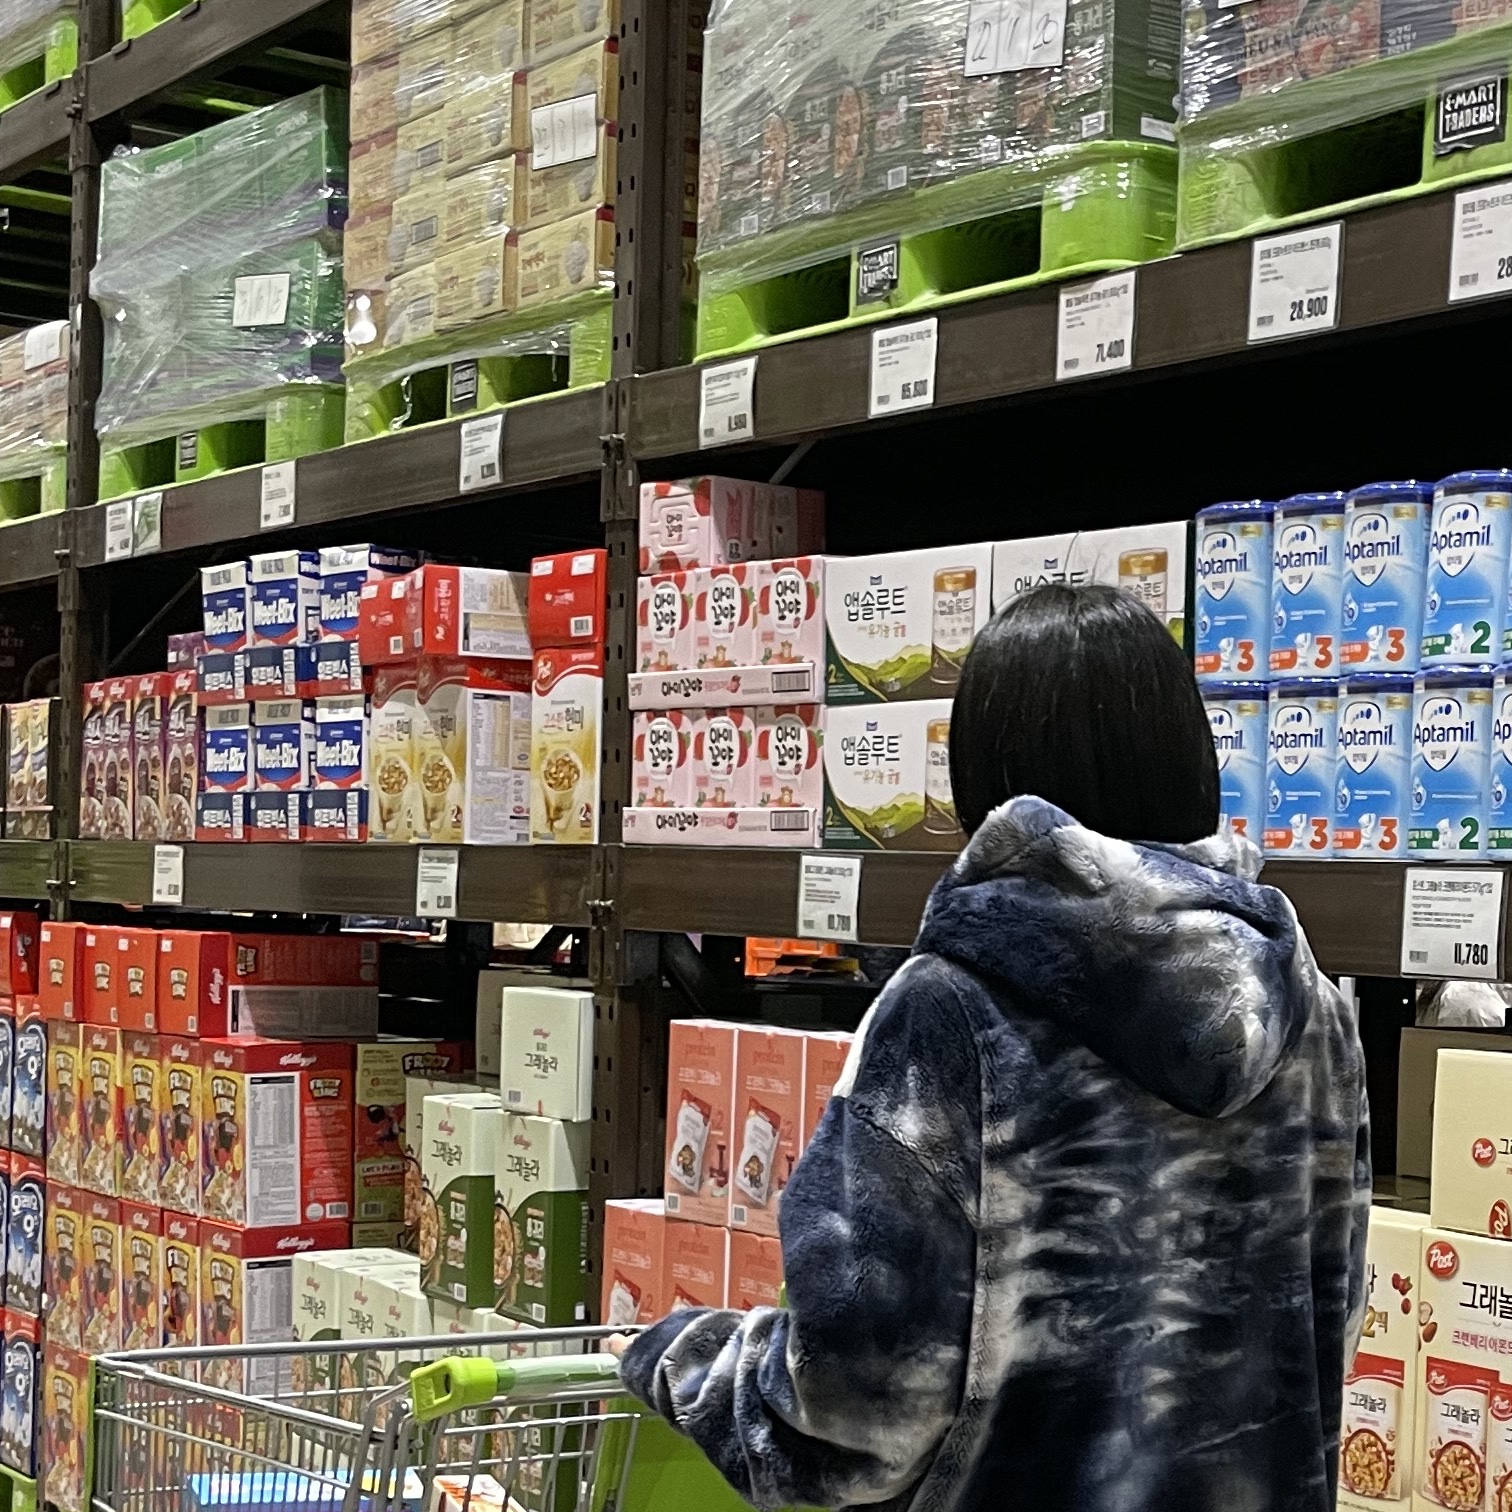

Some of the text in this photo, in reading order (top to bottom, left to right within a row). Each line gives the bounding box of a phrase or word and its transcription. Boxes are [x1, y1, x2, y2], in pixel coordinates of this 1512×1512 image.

[1445, 104, 1496, 133] TRADERS
[1289, 296, 1328, 323] 28,900
[1344, 535, 1401, 562] Aptamil
[1431, 525, 1493, 553] Aptamil
[1197, 552, 1249, 578] Aptamil
[1274, 545, 1328, 573] Aptamil
[844, 588, 906, 622] 앱솔루트
[1386, 629, 1405, 662] 3
[1470, 620, 1491, 654] 2
[1237, 641, 1255, 673] 3
[1315, 637, 1333, 669] 3
[1269, 727, 1325, 752] Aptamil
[1338, 725, 1394, 751] Aptamil
[1414, 721, 1476, 748] Aptamil
[841, 735, 900, 766] 앱솔루트
[1310, 818, 1328, 851] 3
[1379, 817, 1398, 851] 3
[1459, 817, 1480, 850] 2
[1454, 942, 1489, 966] 11,780
[1429, 1248, 1454, 1270] Post
